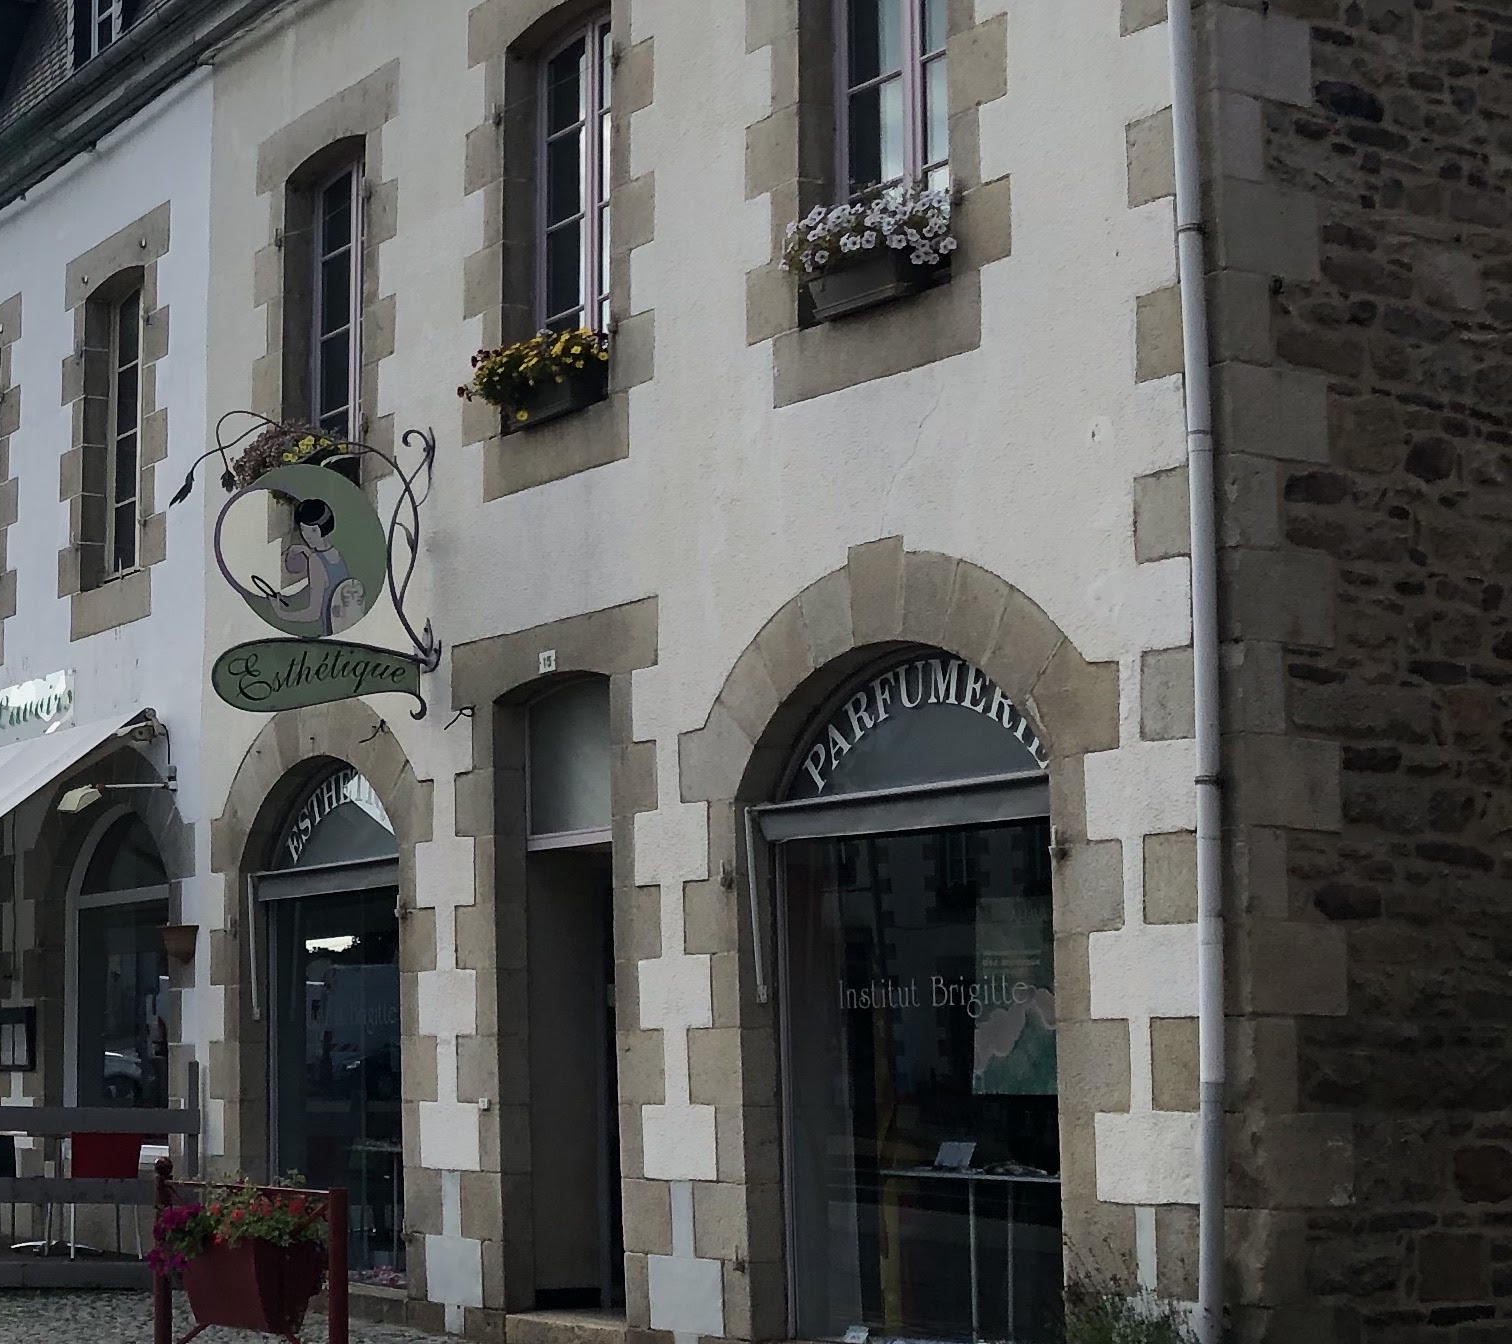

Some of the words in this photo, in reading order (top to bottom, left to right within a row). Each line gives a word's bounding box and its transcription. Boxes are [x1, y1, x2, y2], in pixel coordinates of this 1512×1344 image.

[227, 650, 407, 701] Esthétique
[543, 655, 552, 668] 15
[838, 977, 920, 1010] Institut
[930, 974, 1029, 1018] Brigitte
